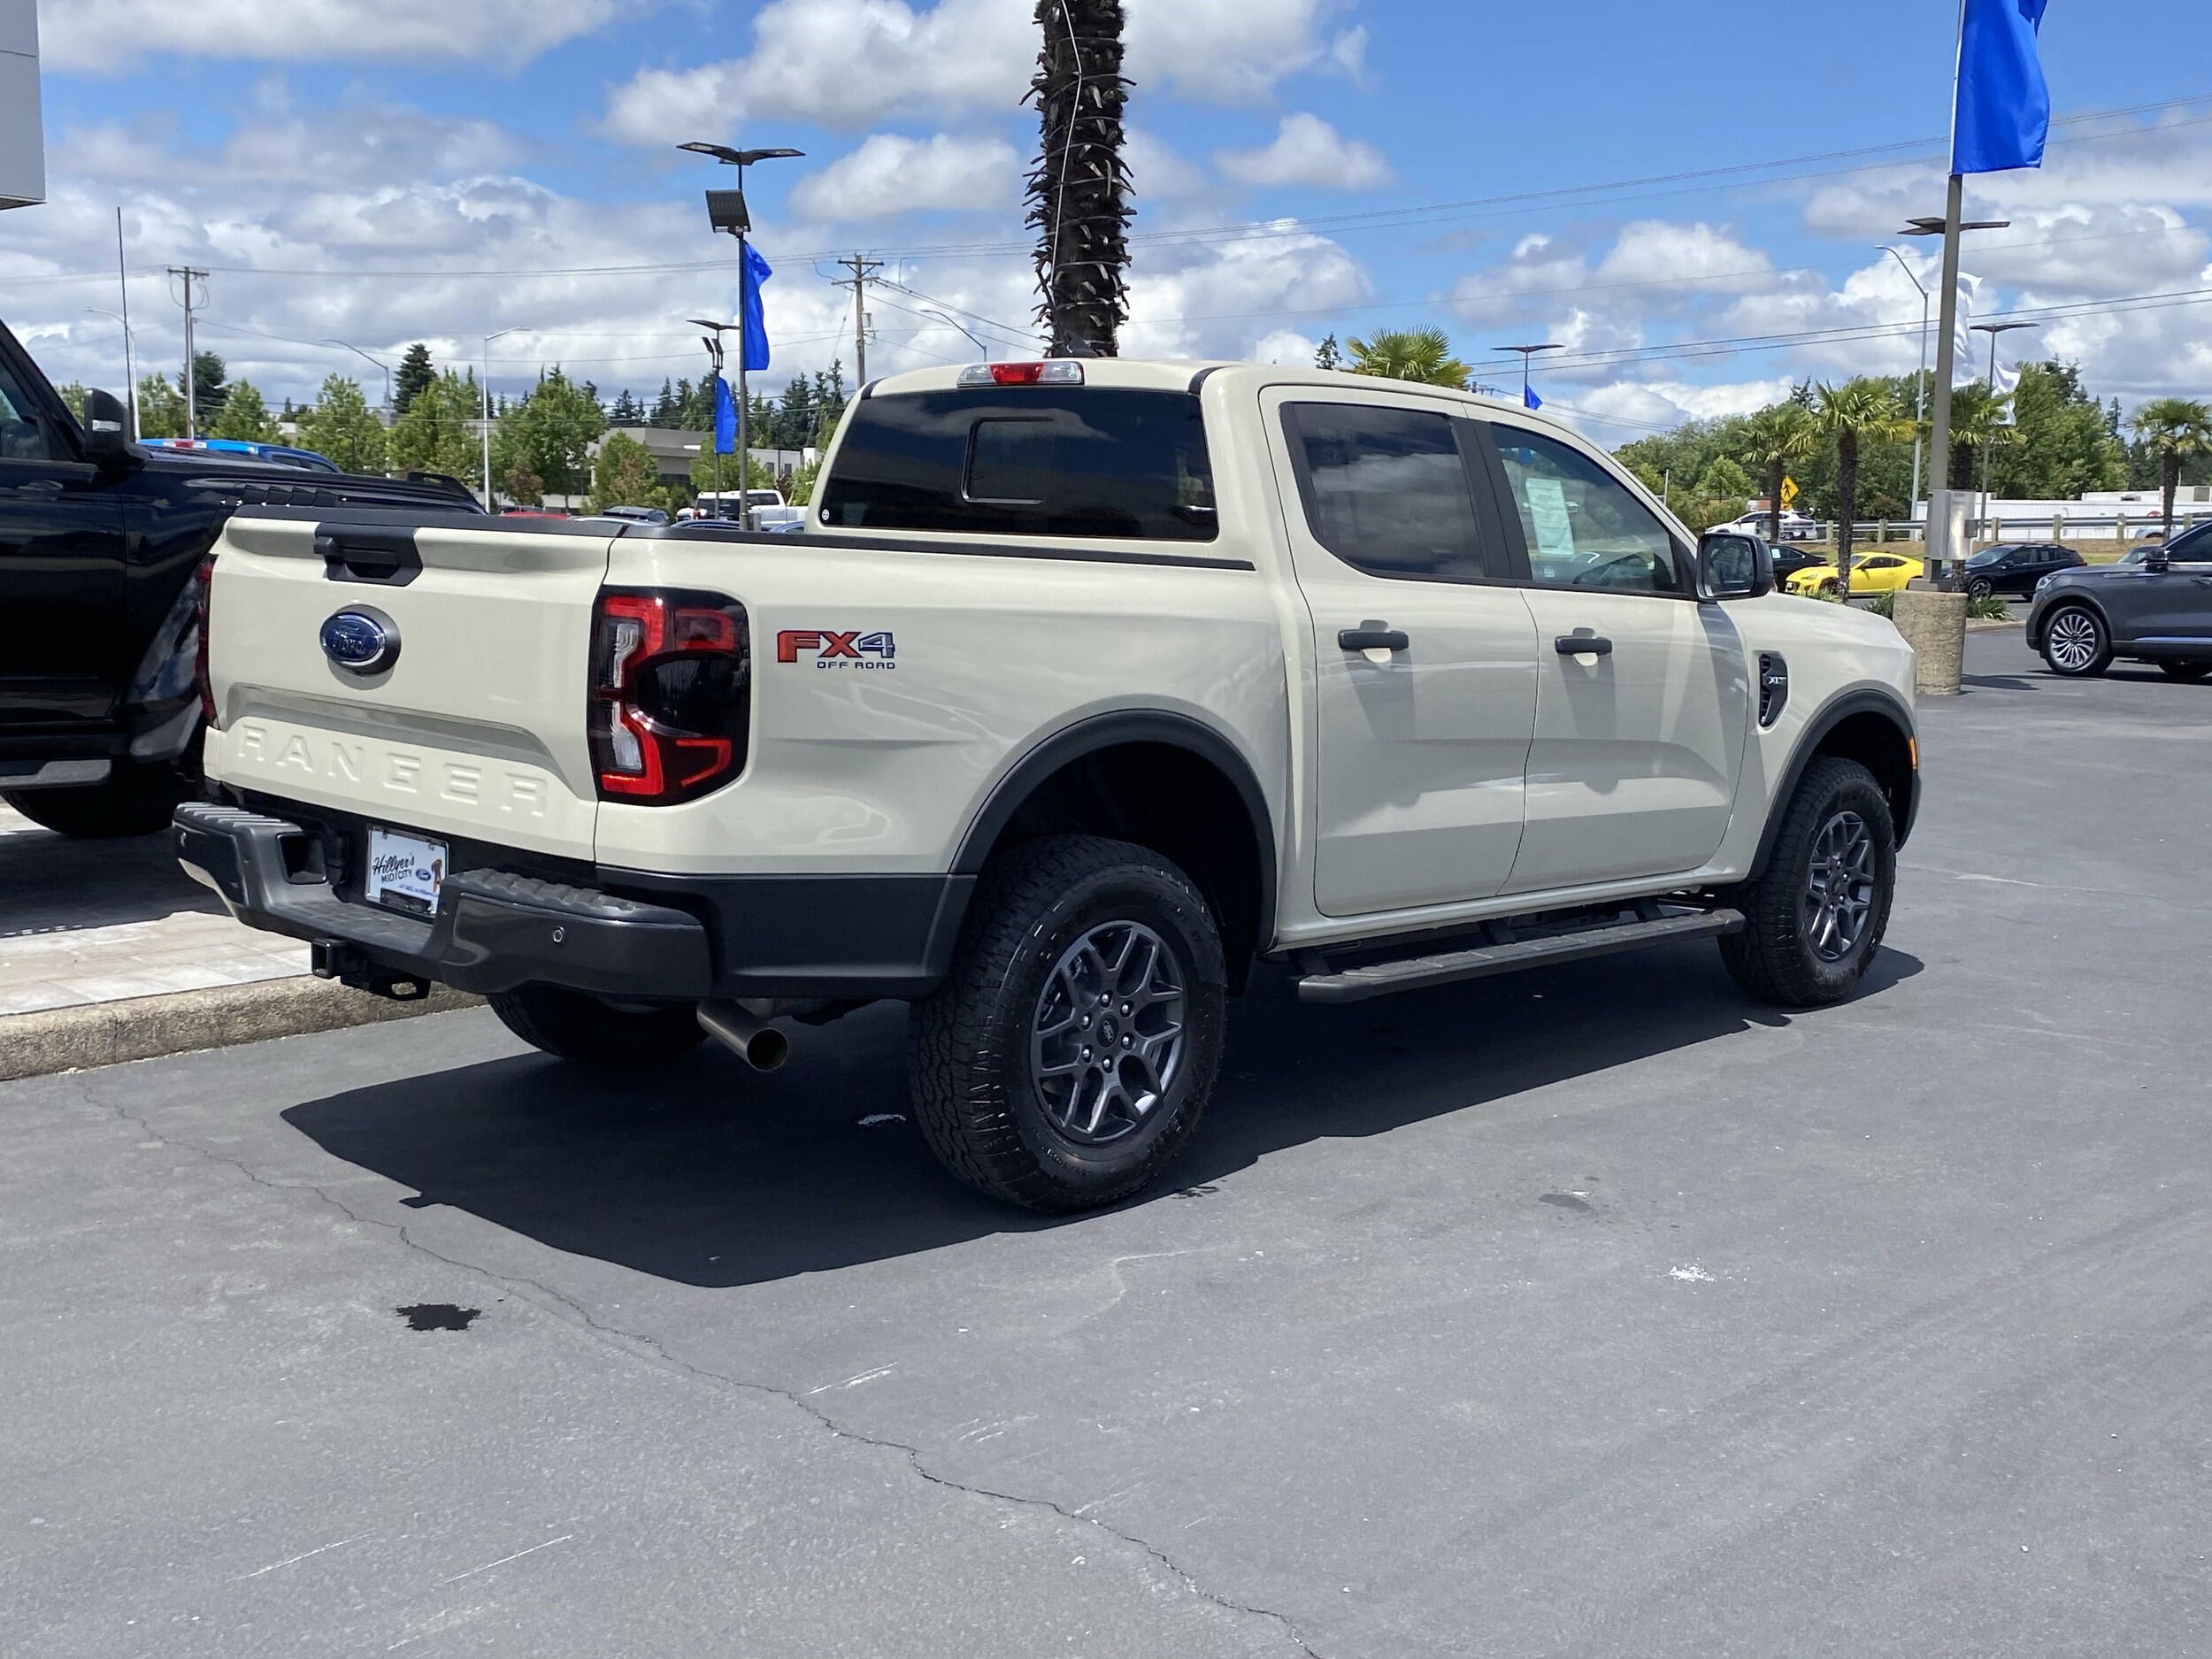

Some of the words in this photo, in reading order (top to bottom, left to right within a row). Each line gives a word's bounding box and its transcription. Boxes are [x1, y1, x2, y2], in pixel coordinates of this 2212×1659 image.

[777, 630, 895, 664] FX4
[1768, 676, 1786, 685] XLT
[237, 725, 548, 817] RANGER
[372, 852, 414, 879] Hillyer's
[398, 869, 412, 879] CITY
